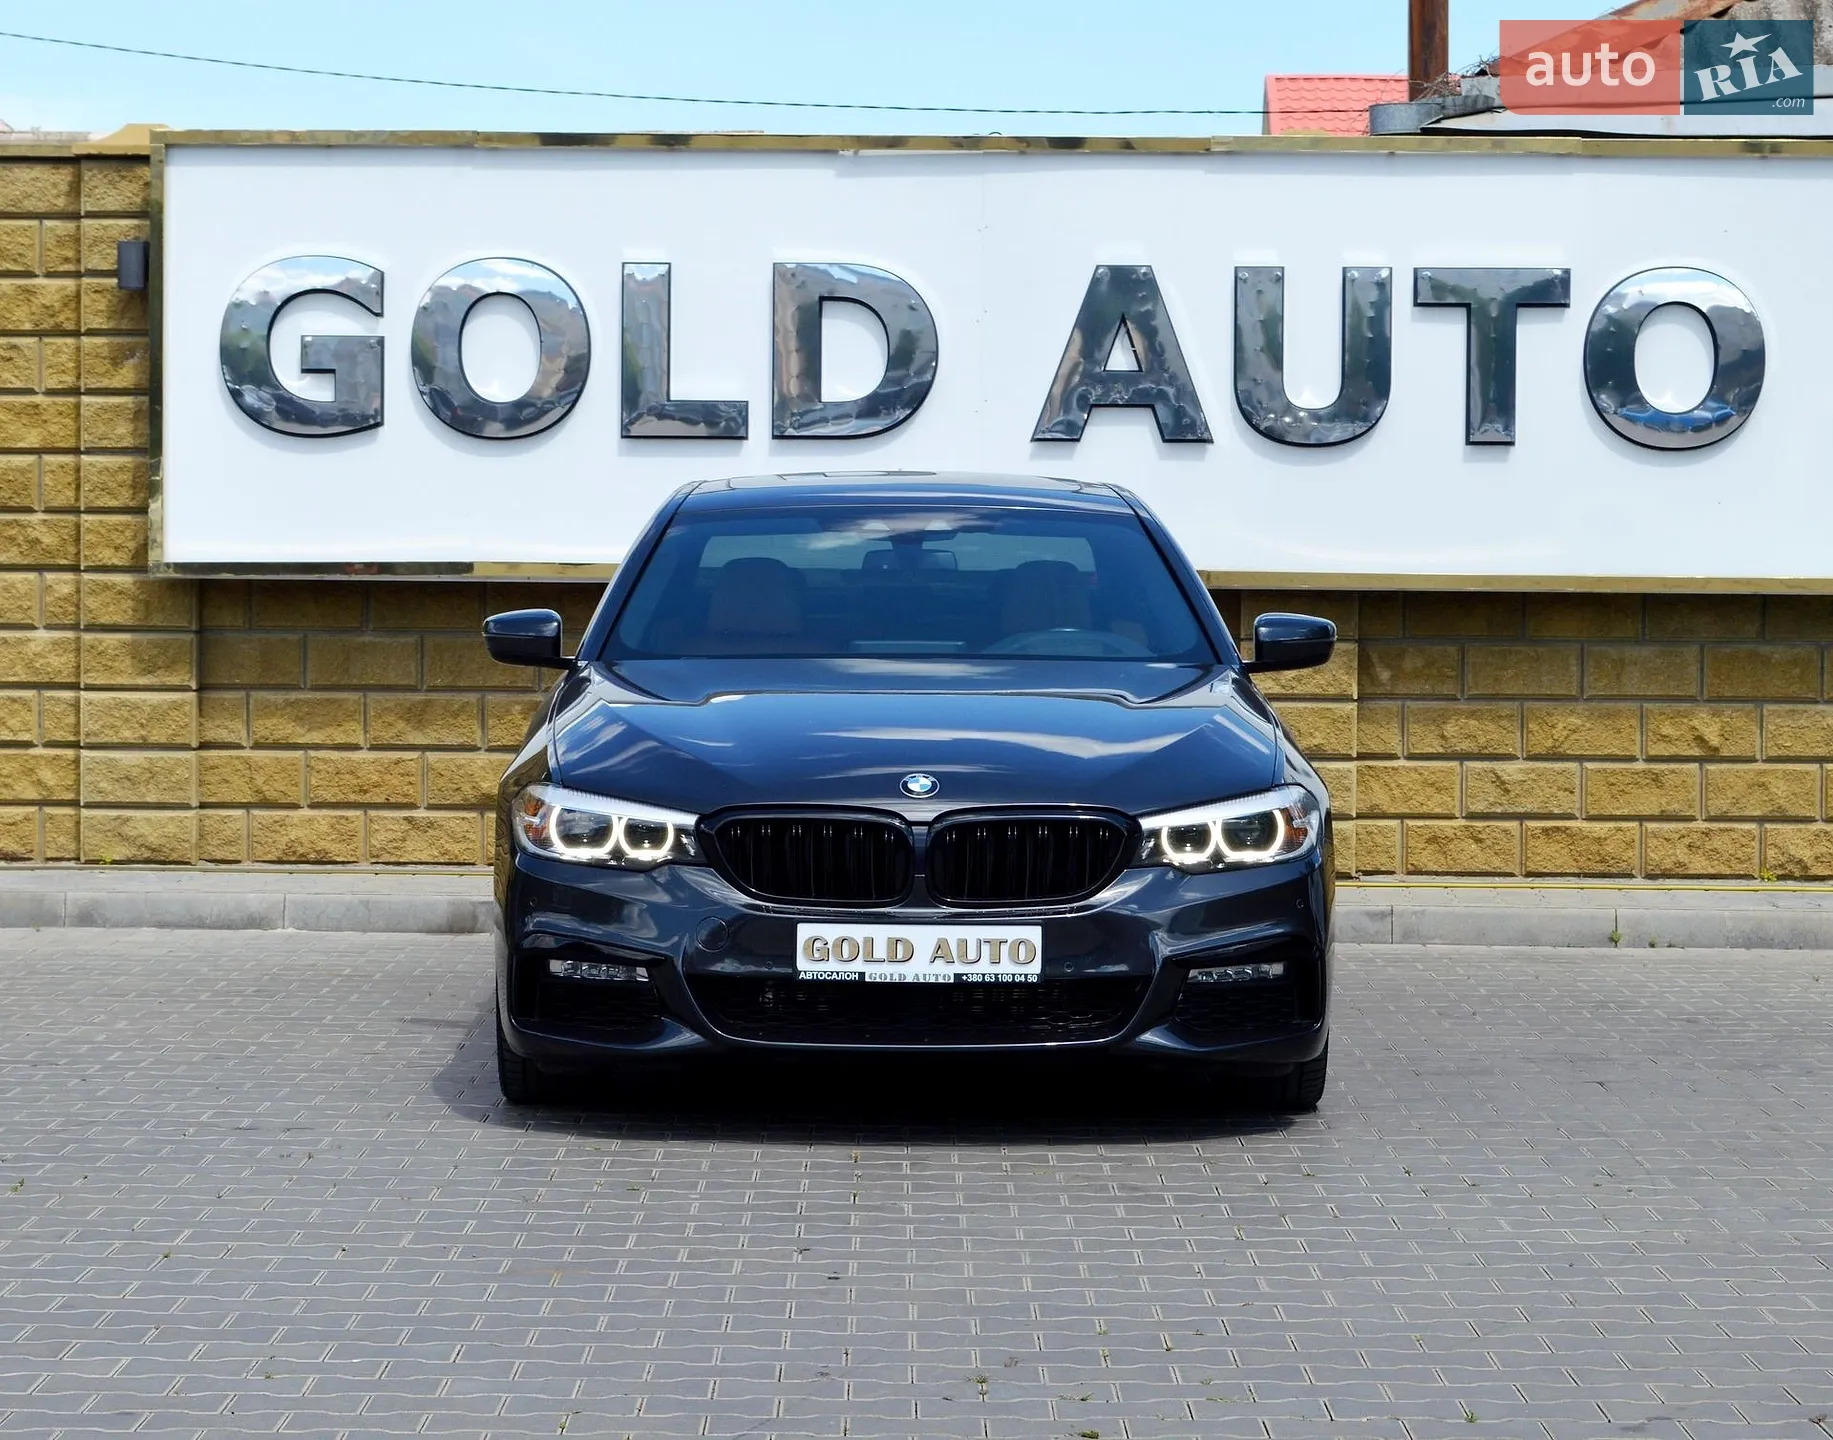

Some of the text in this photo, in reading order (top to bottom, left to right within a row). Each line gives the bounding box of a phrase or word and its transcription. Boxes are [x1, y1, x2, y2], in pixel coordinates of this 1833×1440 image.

[218, 254, 1767, 451] GOLD AUTO
[802, 935, 1037, 965] GOLD AUTO
[798, 971, 860, 981] АВТОСАЛОН
[868, 972, 952, 983] GOLD AUTO
[961, 973, 1038, 983] +380 63 100 04 50
